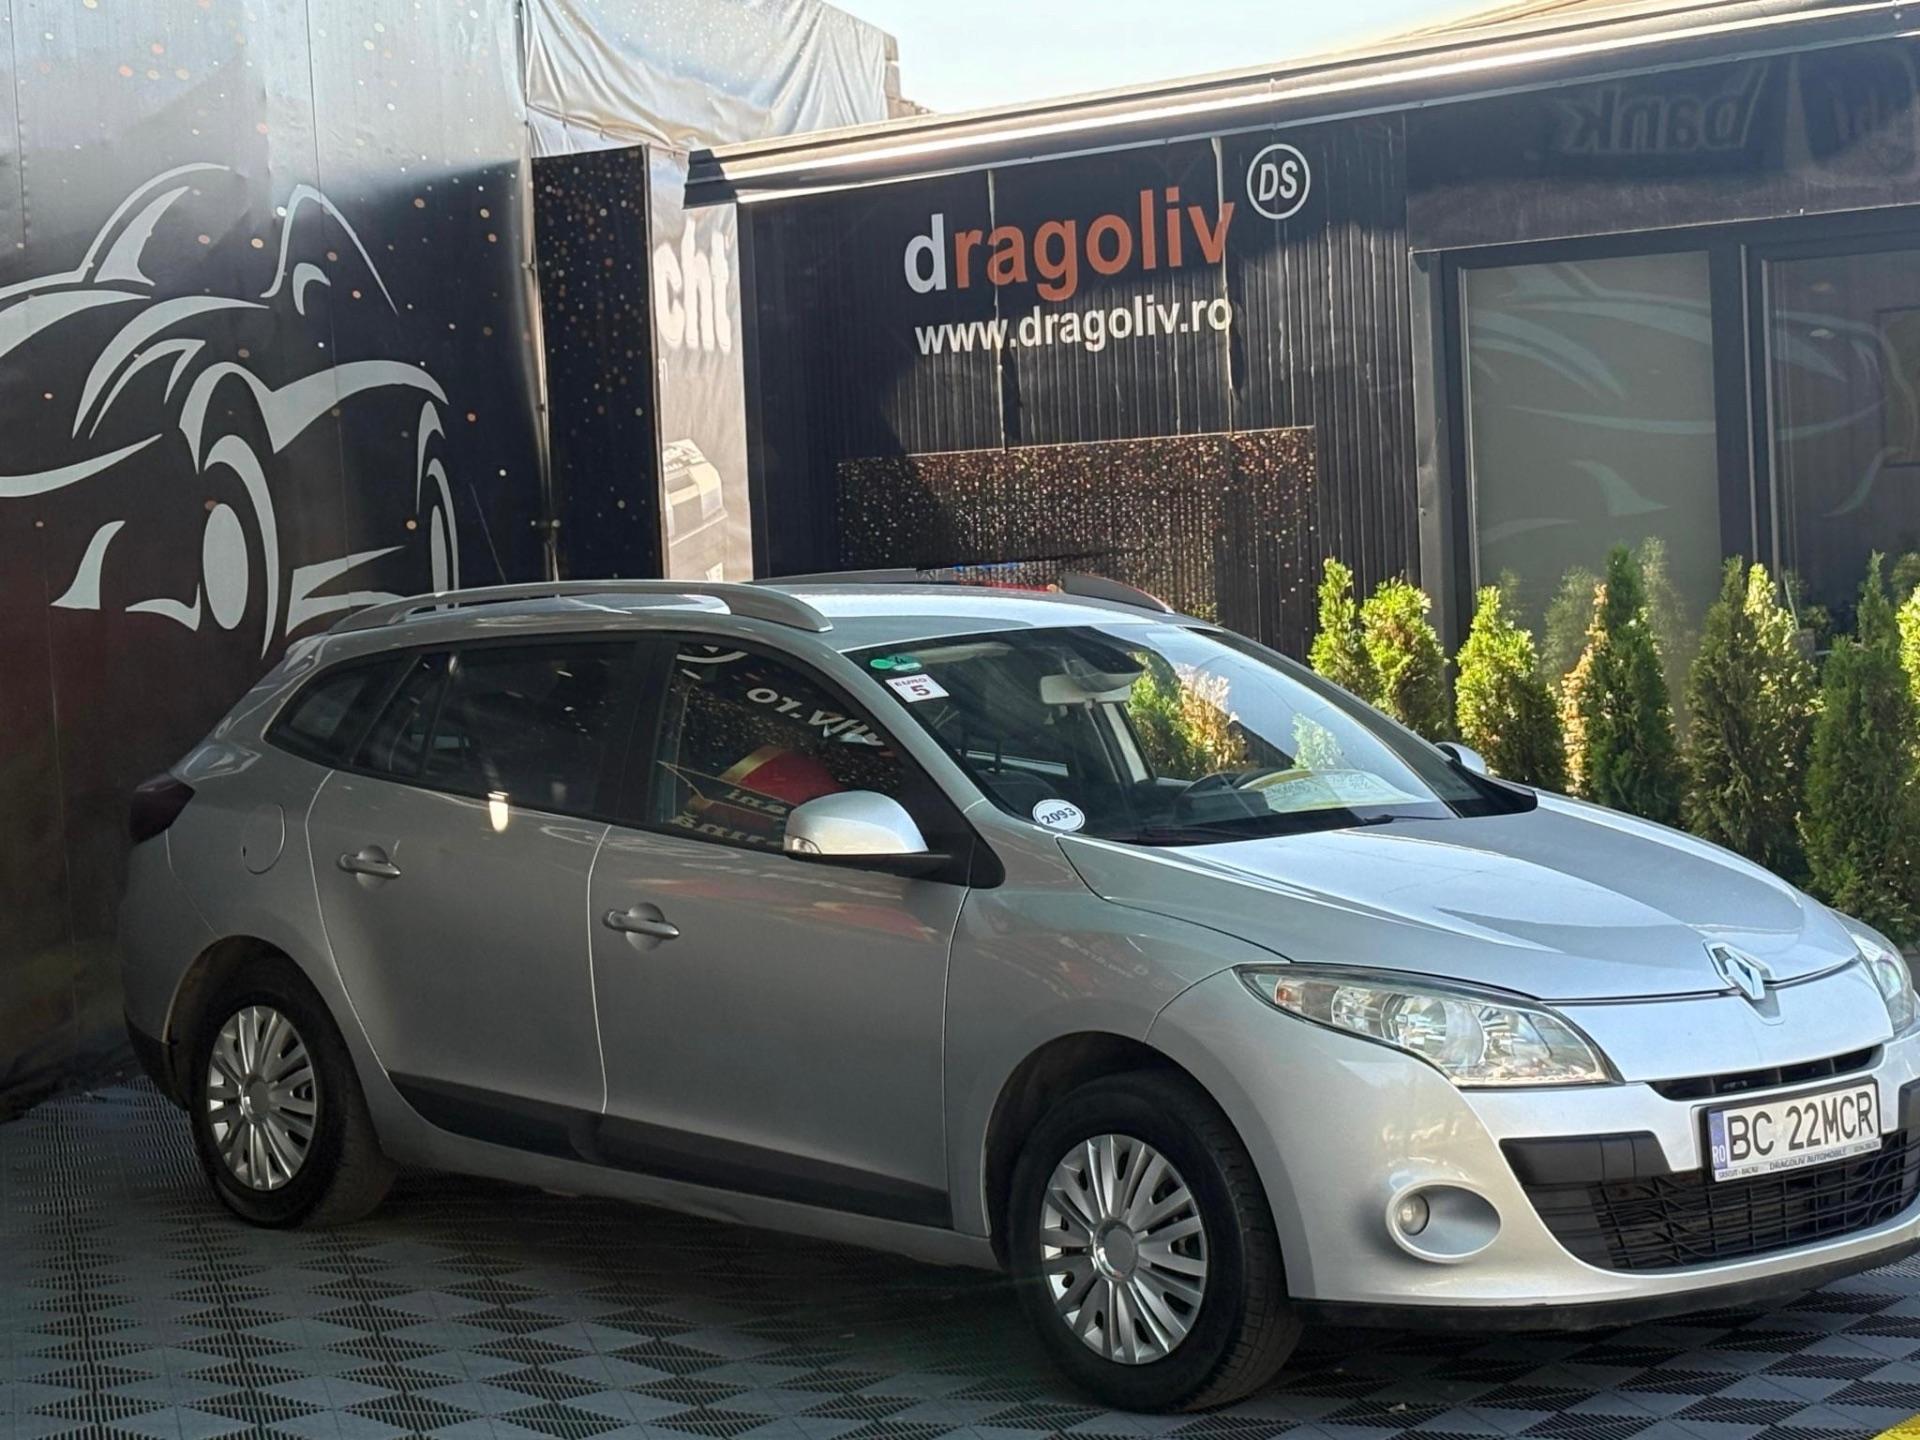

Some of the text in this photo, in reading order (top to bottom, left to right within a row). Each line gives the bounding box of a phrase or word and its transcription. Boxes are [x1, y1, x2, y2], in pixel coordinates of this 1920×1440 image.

[1257, 159, 1299, 202] DS
[904, 186, 1235, 302] dragoliv
[914, 295, 1233, 356] www.dragoliv.ro
[893, 677, 928, 688] EURO
[909, 684, 931, 697] 5
[1041, 806, 1077, 825] 2093
[1727, 1091, 1874, 1161] BC 22MCR
[1713, 1145, 1726, 1169] RO
